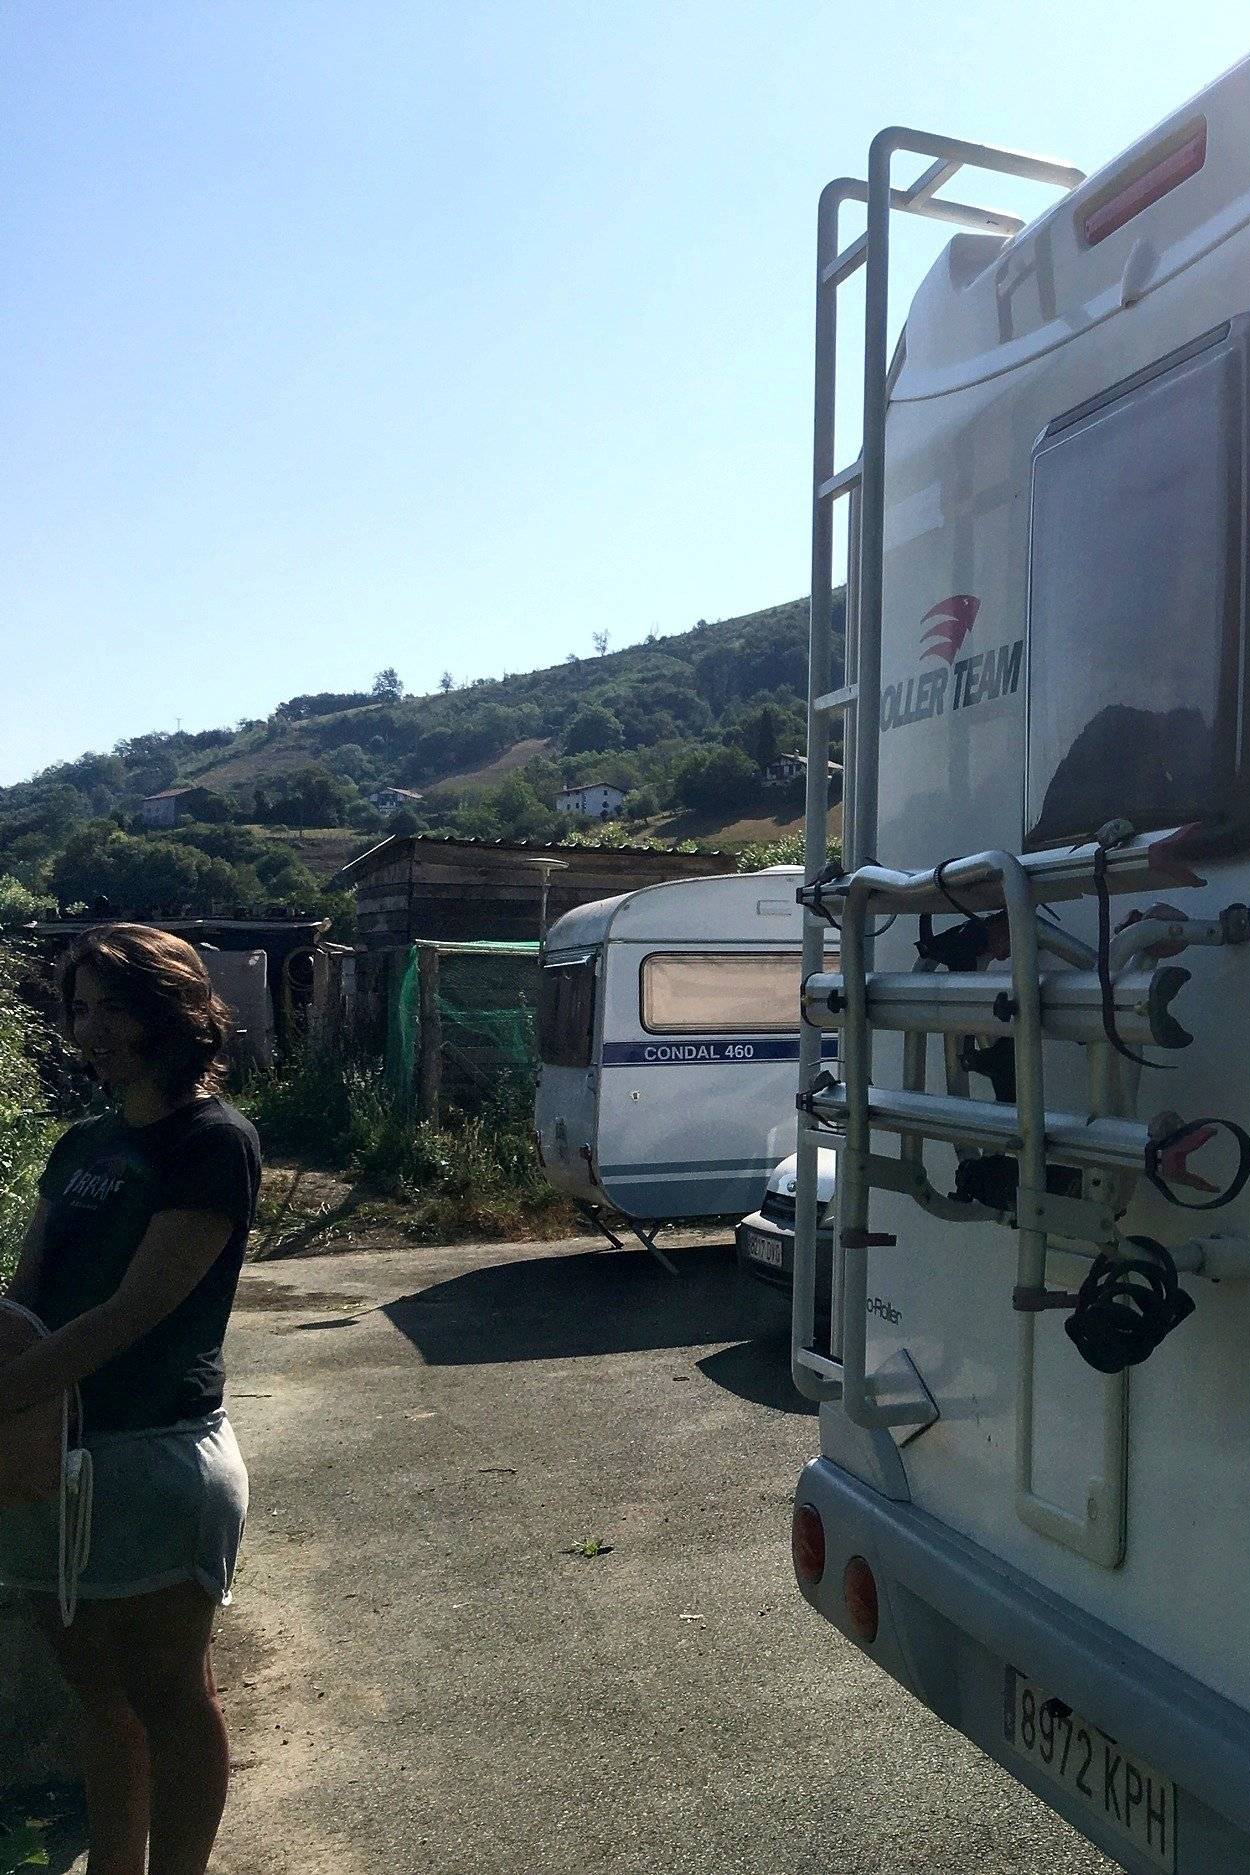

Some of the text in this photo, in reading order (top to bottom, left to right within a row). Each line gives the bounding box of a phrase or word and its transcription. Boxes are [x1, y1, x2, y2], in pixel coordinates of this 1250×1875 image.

[880, 639, 1024, 733] OLLER TEAM
[644, 1044, 754, 1061] CONDAL 460
[866, 1297, 903, 1326] o-Roller
[1021, 1688, 1166, 1855] 8972 KPH
